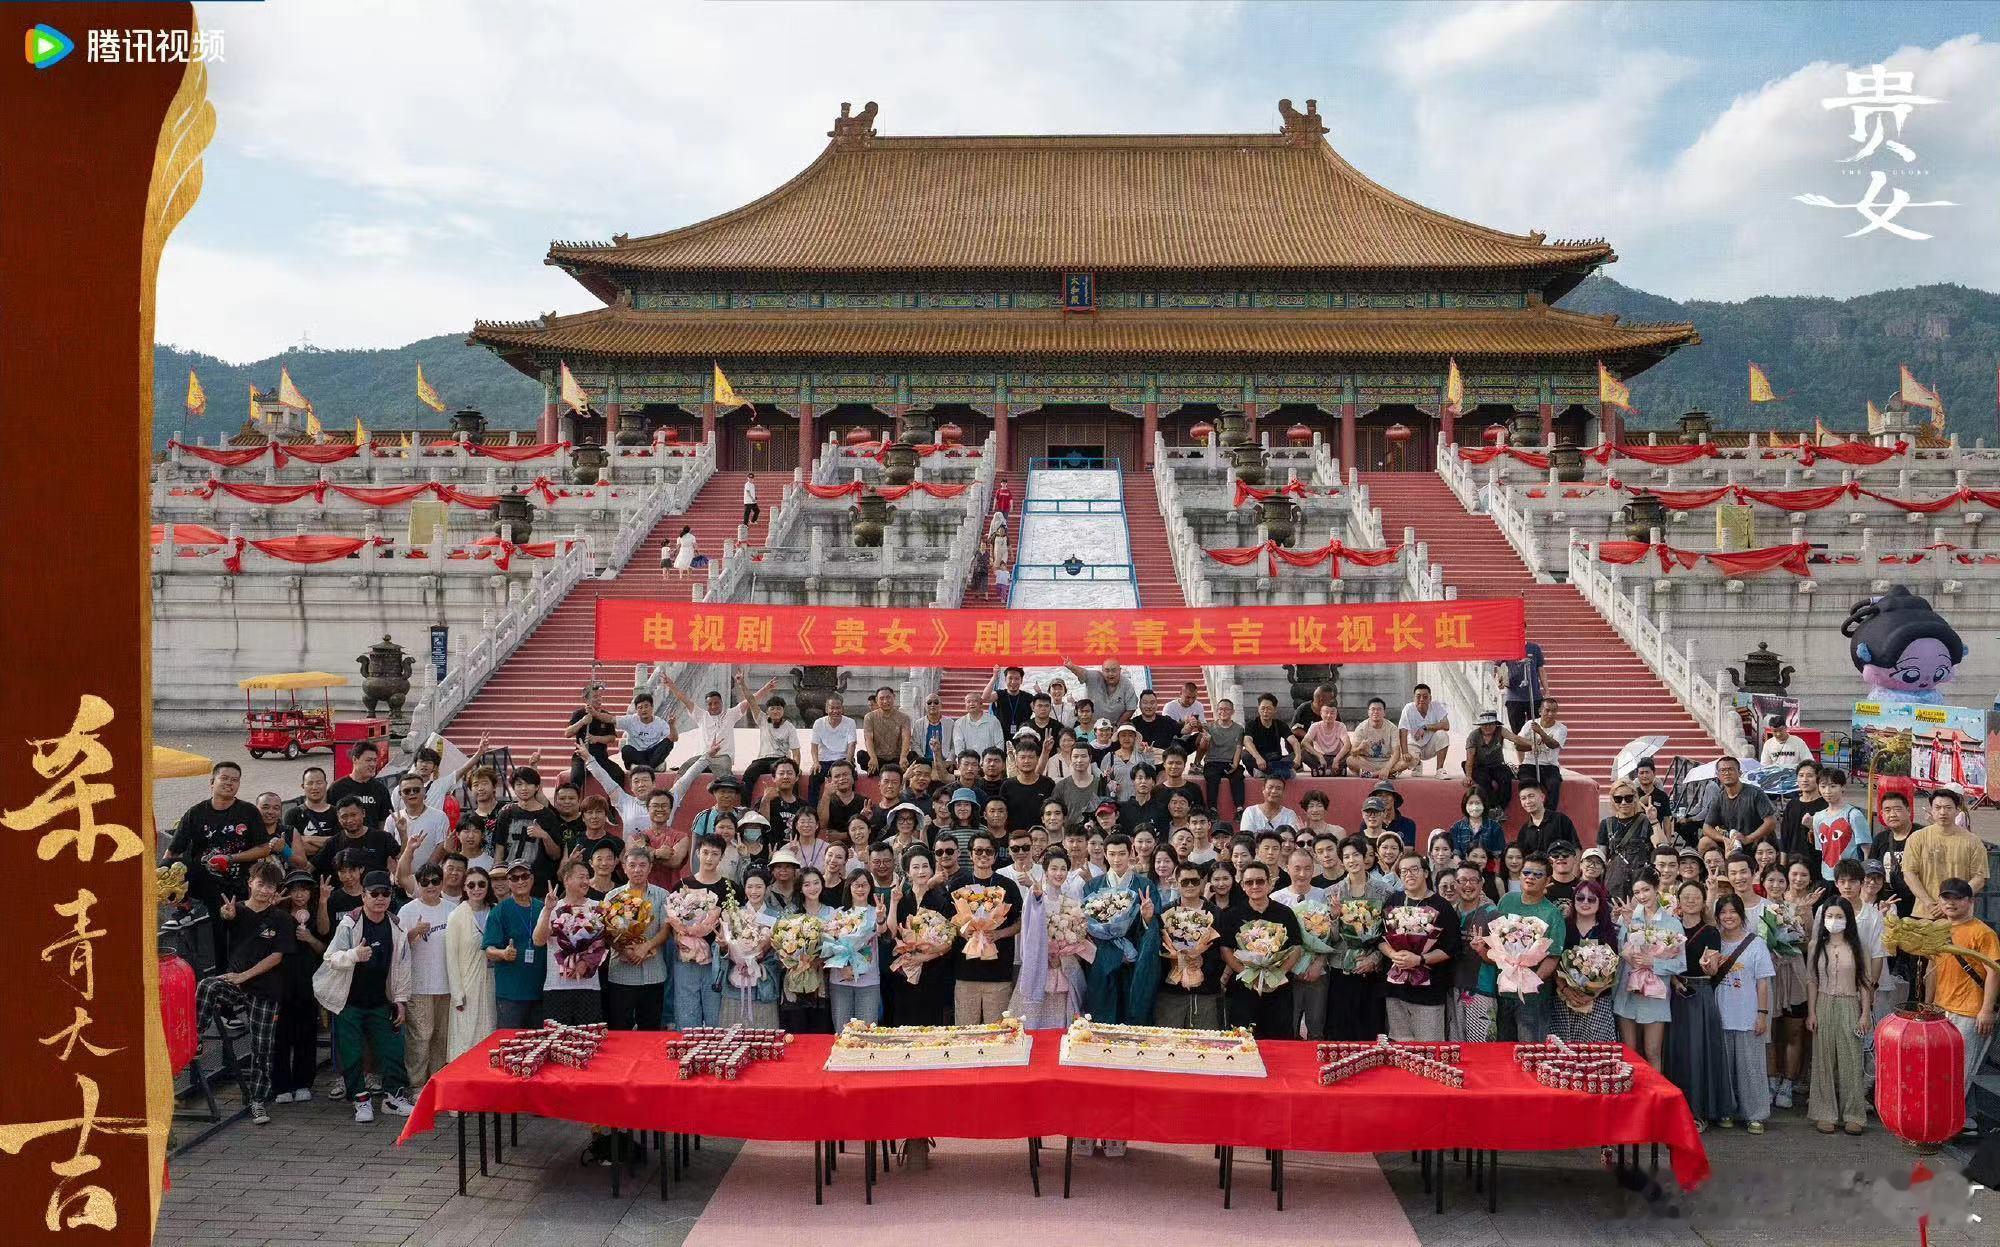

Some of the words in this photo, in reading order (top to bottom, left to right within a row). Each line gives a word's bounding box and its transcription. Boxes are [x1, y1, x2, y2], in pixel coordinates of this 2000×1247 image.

[642, 611, 1059, 656] 电视剧《贵女》剧组
[1085, 616, 1264, 656] 杀青大吉
[1289, 611, 1475, 655] 收视长虹
